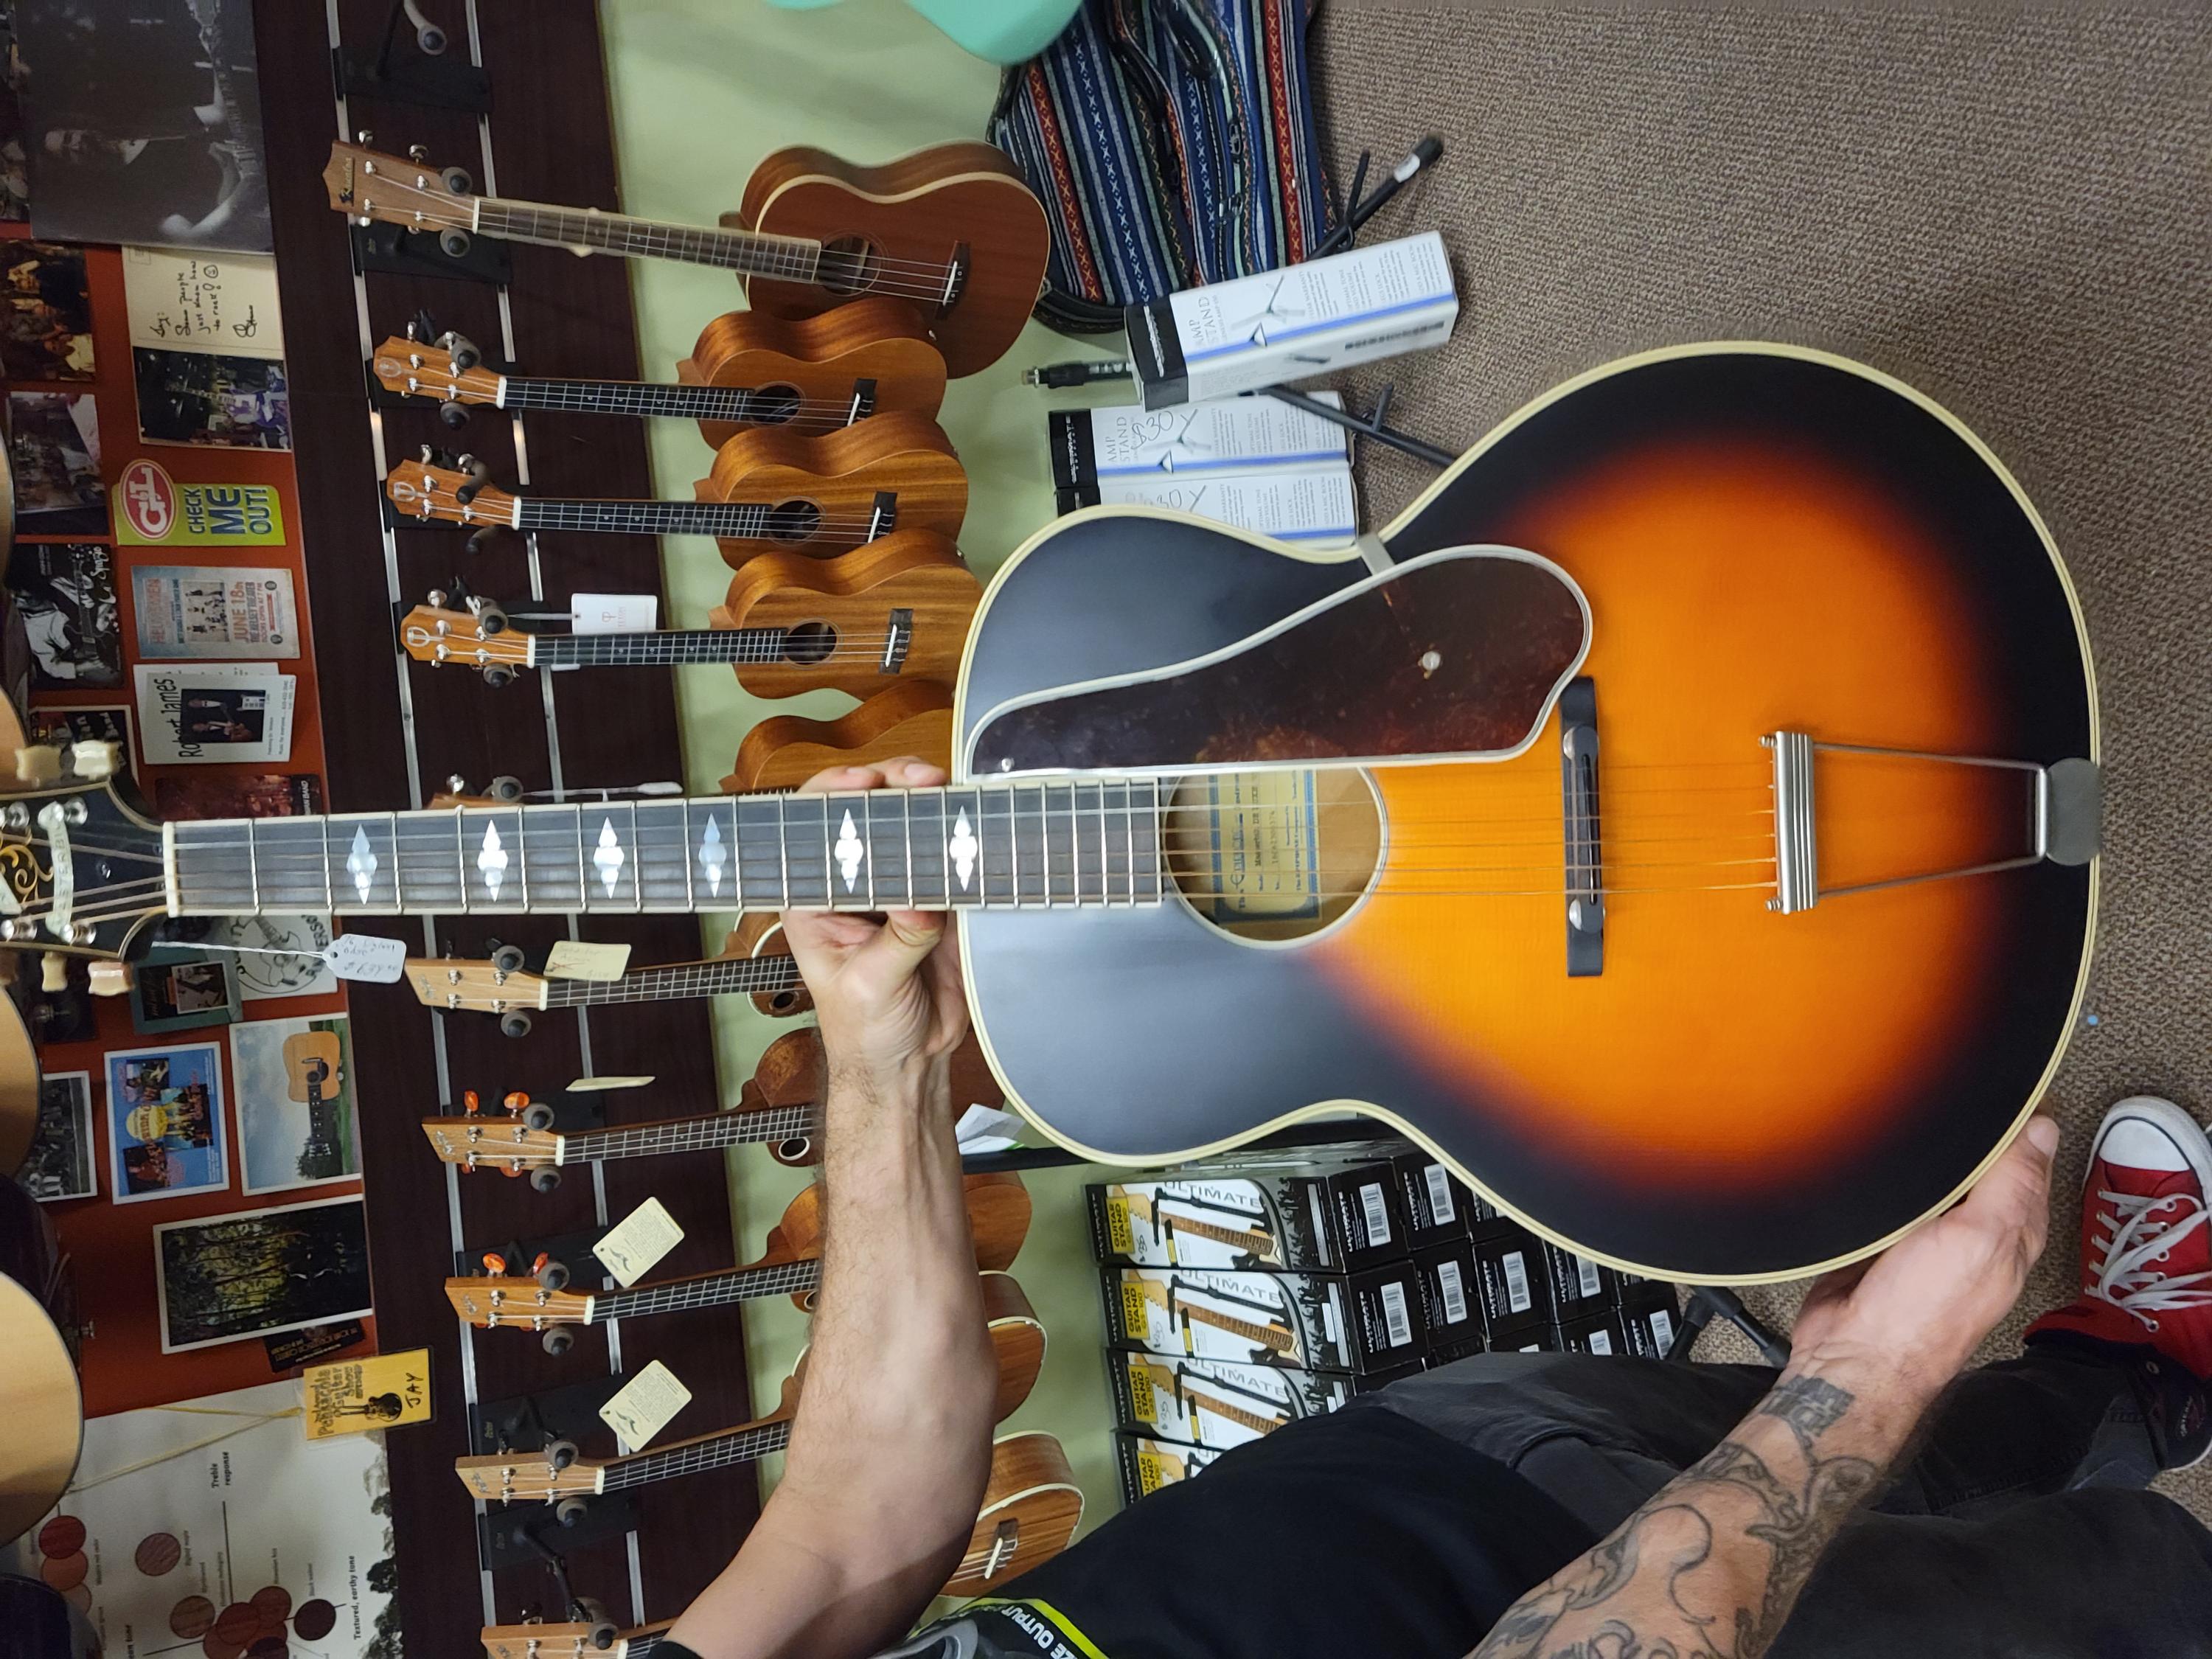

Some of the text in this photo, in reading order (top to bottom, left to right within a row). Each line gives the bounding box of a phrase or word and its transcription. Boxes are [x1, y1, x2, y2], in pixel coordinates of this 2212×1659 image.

[1189, 319, 1204, 343] AMP
[1198, 296, 1217, 342] STAND
[1105, 437, 1117, 462] AMP
[1116, 417, 1130, 462] STAND
[1132, 411, 1174, 449] $30
[184, 488, 206, 535] CHECK
[206, 488, 247, 535] ME
[245, 489, 272, 535] OUT!
[230, 582, 248, 641] JUNE 18th
[153, 679, 182, 714] James
[1338, 1192, 1353, 1252] ULTIMATE
[1404, 1172, 1419, 1231] ULTIMATE
[1109, 1203, 1119, 1248] GUITAR
[1115, 1203, 1127, 1248] STAND
[1124, 1287, 1135, 1332] GUITAR
[1130, 1288, 1141, 1332] STAND
[1138, 1293, 1147, 1329] GS-100
[1417, 1270, 1430, 1329] ULTIMATE
[1482, 1260, 1496, 1319] ULTIMATE
[1360, 1291, 1374, 1353] ULTIMATE
[406, 1373, 423, 1408] JAY
[1130, 1371, 1142, 1416] GUITAR
[1137, 1371, 1150, 1416] STAND
[1144, 1376, 1155, 1413] GS-100
[211, 1463, 219, 1488] Treble
[222, 1452, 232, 1486] response
[1141, 1457, 1151, 1492] UITAR
[349, 1575, 359, 1600] earthy
[353, 1602, 361, 1640] Textured,
[1001, 1606, 1054, 1648] OUTPUT
